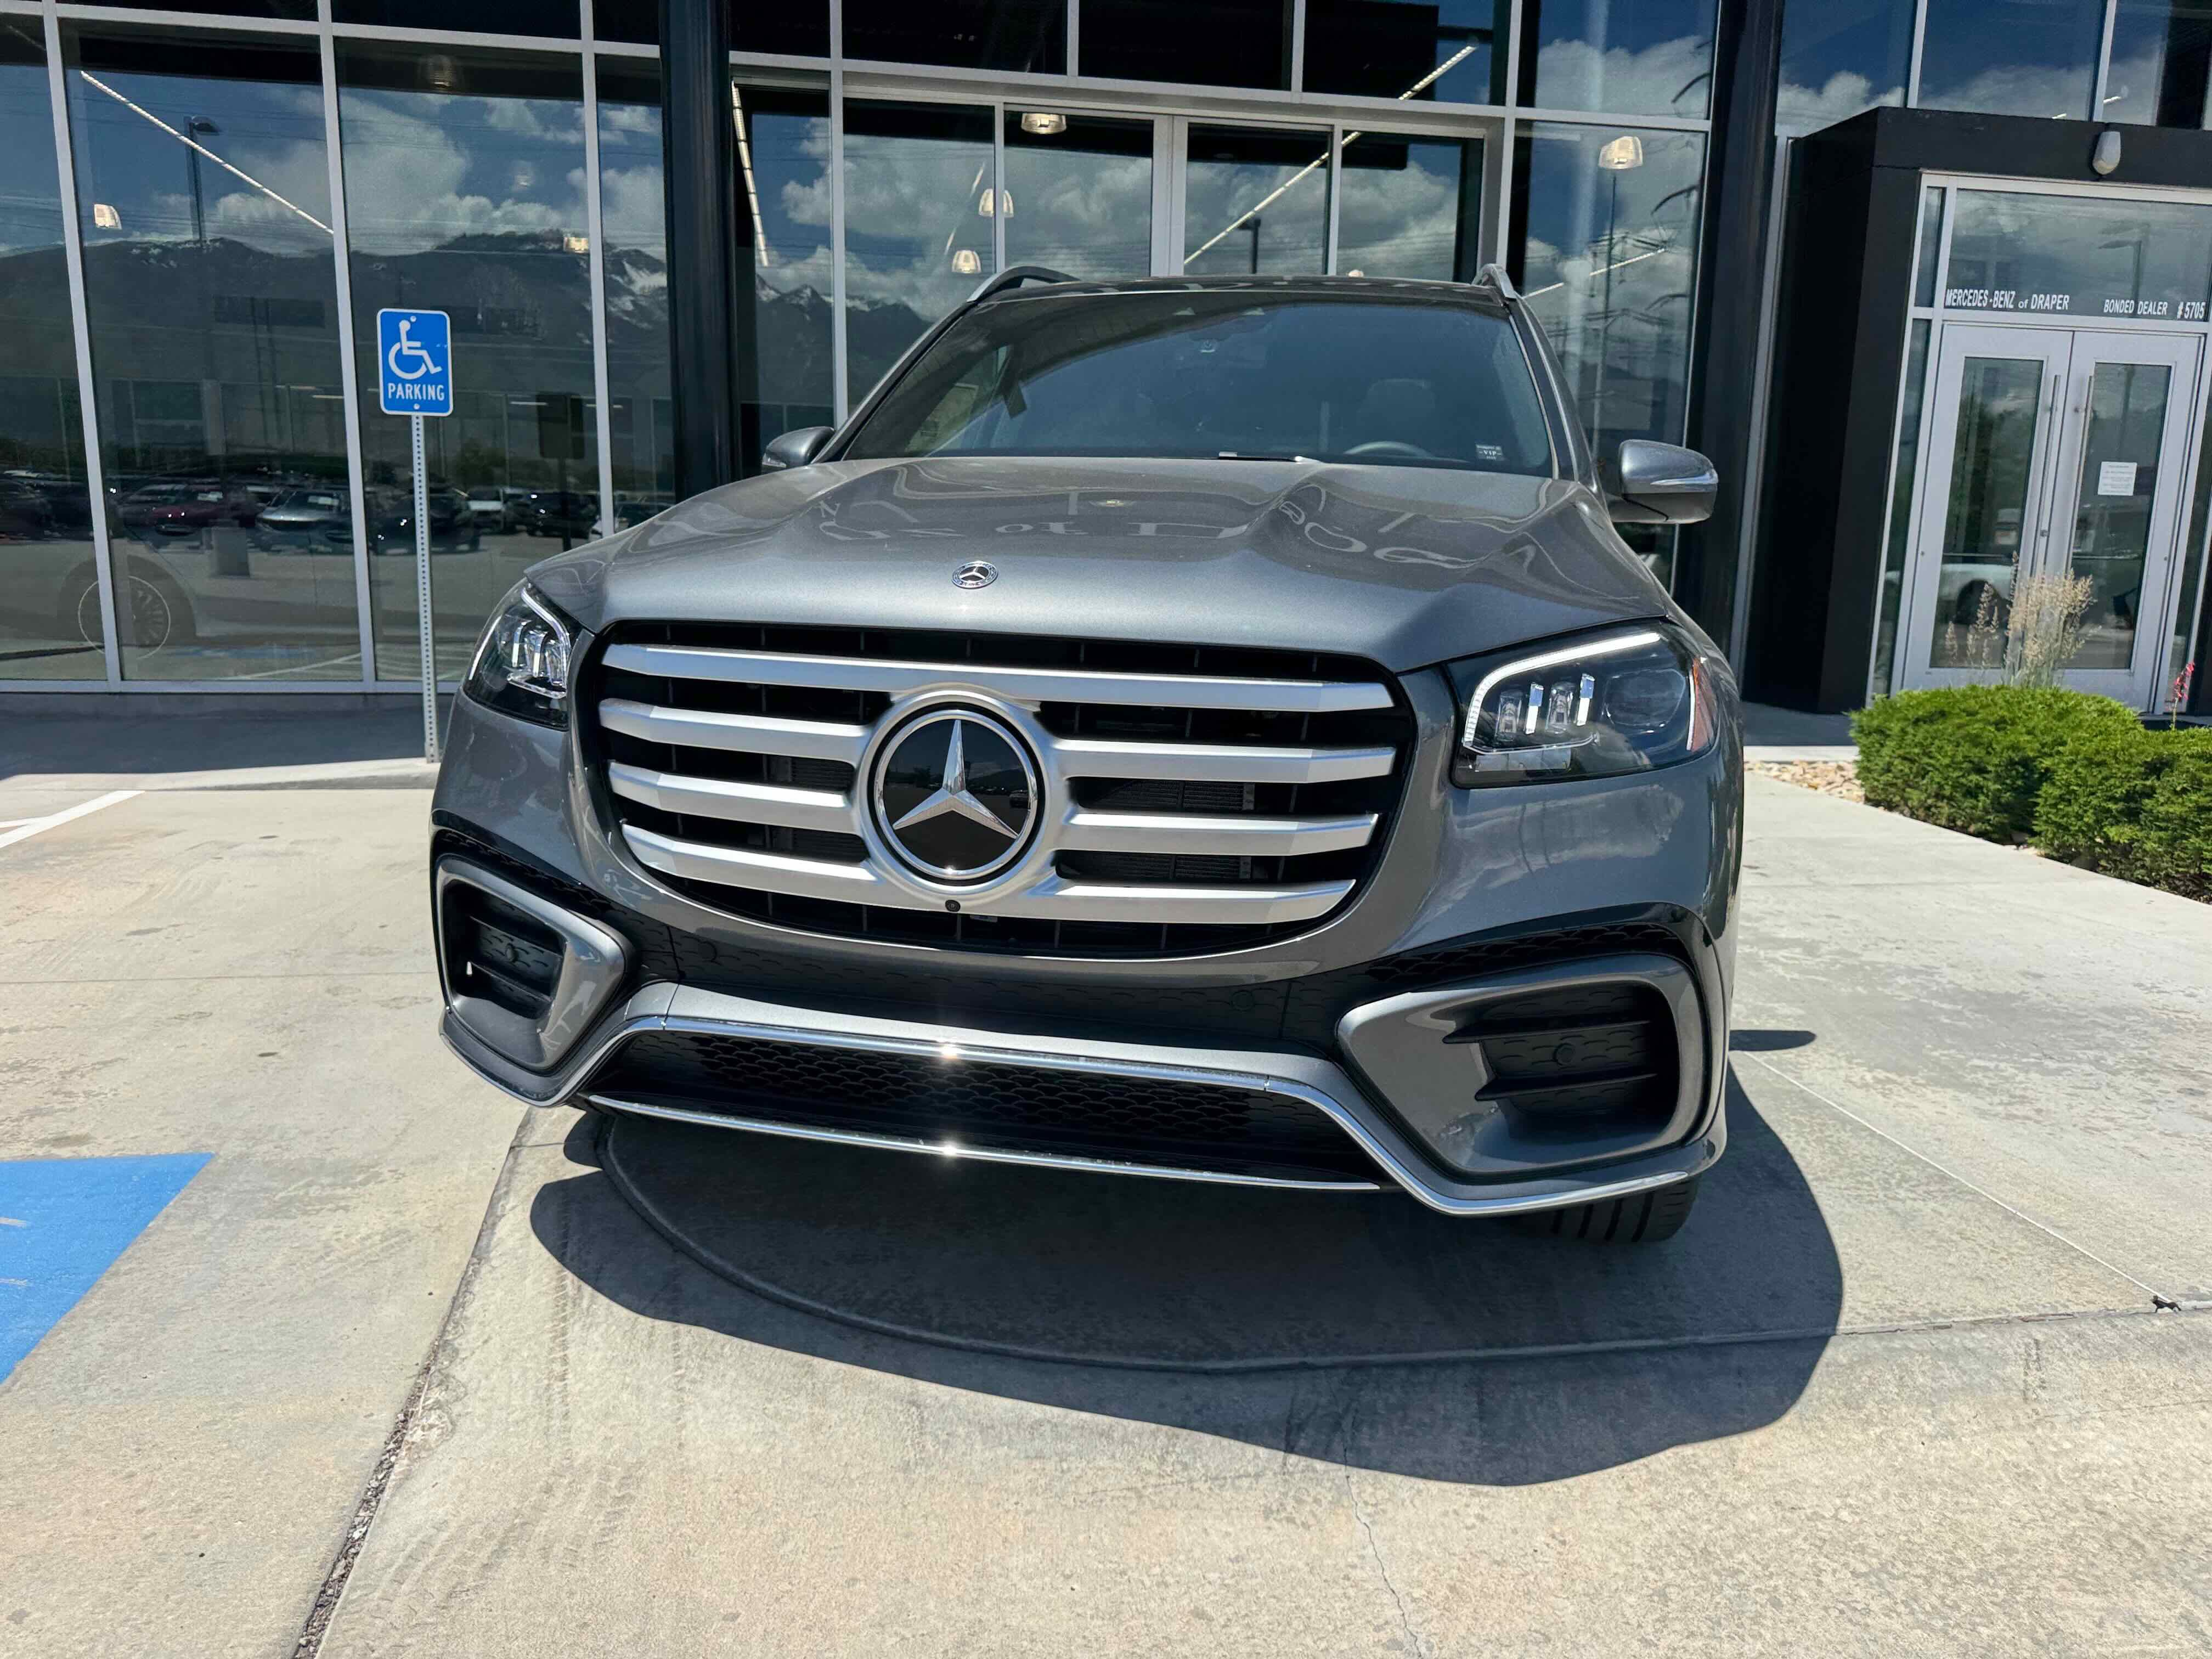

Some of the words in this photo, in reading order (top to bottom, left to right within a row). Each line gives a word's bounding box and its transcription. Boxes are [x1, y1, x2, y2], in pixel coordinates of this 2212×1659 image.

[2018, 298, 2029, 309] of
[2030, 294, 2070, 311] DRAPER
[2103, 299, 2135, 314] BONDED
[2137, 301, 2168, 315] DEALER
[387, 382, 445, 401] PARKING
